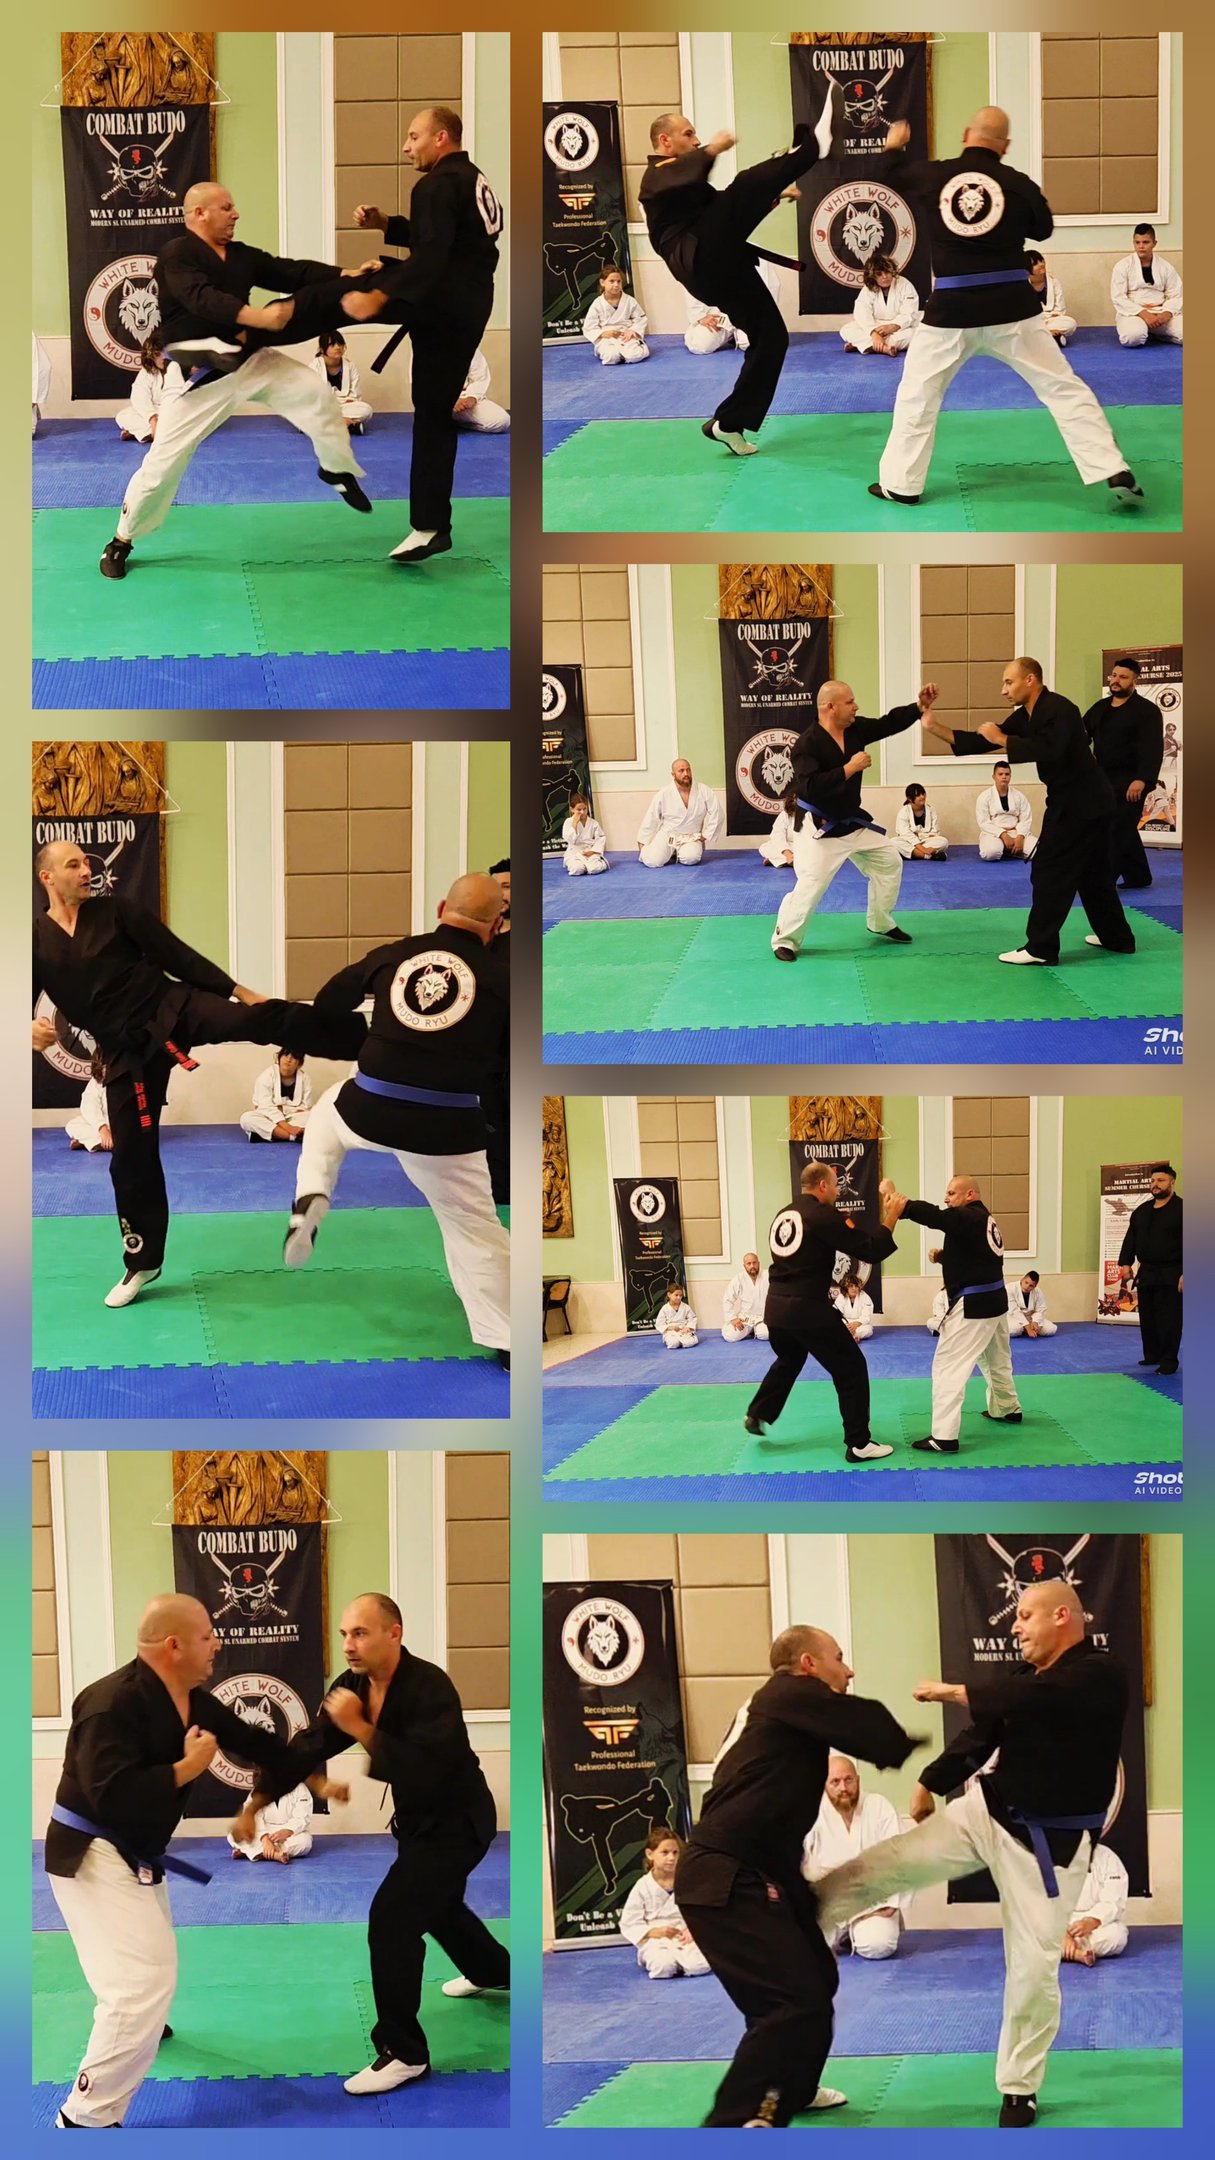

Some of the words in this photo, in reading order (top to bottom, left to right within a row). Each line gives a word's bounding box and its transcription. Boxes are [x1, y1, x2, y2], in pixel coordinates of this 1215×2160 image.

[812, 50, 865, 71] COMBAT
[869, 48, 904, 70] BUDO
[86, 113, 144, 136] COMBAT
[147, 110, 186, 134] BUDO
[860, 138, 887, 147] REAL
[824, 188, 860, 213] WHITE
[868, 187, 900, 210] WOLF
[90, 209, 114, 218] WAY
[118, 208, 134, 218] OF
[99, 262, 138, 289] WHITE
[828, 262, 865, 284] MUDO
[103, 342, 142, 366] MUDO
[737, 623, 780, 640] COMBAT
[782, 622, 811, 639] BUDO
[740, 694, 758, 702] WAY
[761, 694, 773, 702] OF
[775, 692, 812, 701] REALITY
[747, 733, 776, 754] WHITE
[749, 793, 780, 810] MUDO
[36, 821, 93, 845] COMBAT
[97, 819, 136, 843] BUDO
[411, 955, 442, 967] WHITE
[448, 957, 469, 979] WOLF
[396, 1002, 420, 1025] MUDO
[425, 1015, 448, 1027] RYU
[52, 1051, 92, 1075] MUDO
[804, 1144, 839, 1158] COMBAT
[841, 1143, 864, 1157] BUDO
[197, 1531, 255, 1554] COMBAT
[258, 1528, 298, 1553] BUDO
[572, 1602, 600, 1622] WHITE
[604, 1602, 629, 1621] WOLF
[212, 1628, 226, 1637] AY
[230, 1627, 245, 1637] OF
[250, 1624, 299, 1636] REALITY
[972, 1638, 1007, 1651] WAY
[973, 1653, 1003, 1661] MODERN
[578, 1662, 608, 1681] MUDO
[612, 1663, 632, 1680] RYU
[219, 1680, 250, 1701] HITE
[257, 1679, 292, 1704] WOLF
[583, 1705, 626, 1715] Recognized
[627, 1704, 637, 1714] by
[591, 1749, 636, 1759] Professional
[214, 1761, 254, 1784] MUDO
[574, 1762, 616, 1771] Taekwondo
[617, 1760, 656, 1769] Federation
[566, 1911, 590, 1922] Don't
[592, 1910, 605, 1920] Be
[606, 1911, 613, 1919] a
[580, 1921, 616, 1932] Unleash
